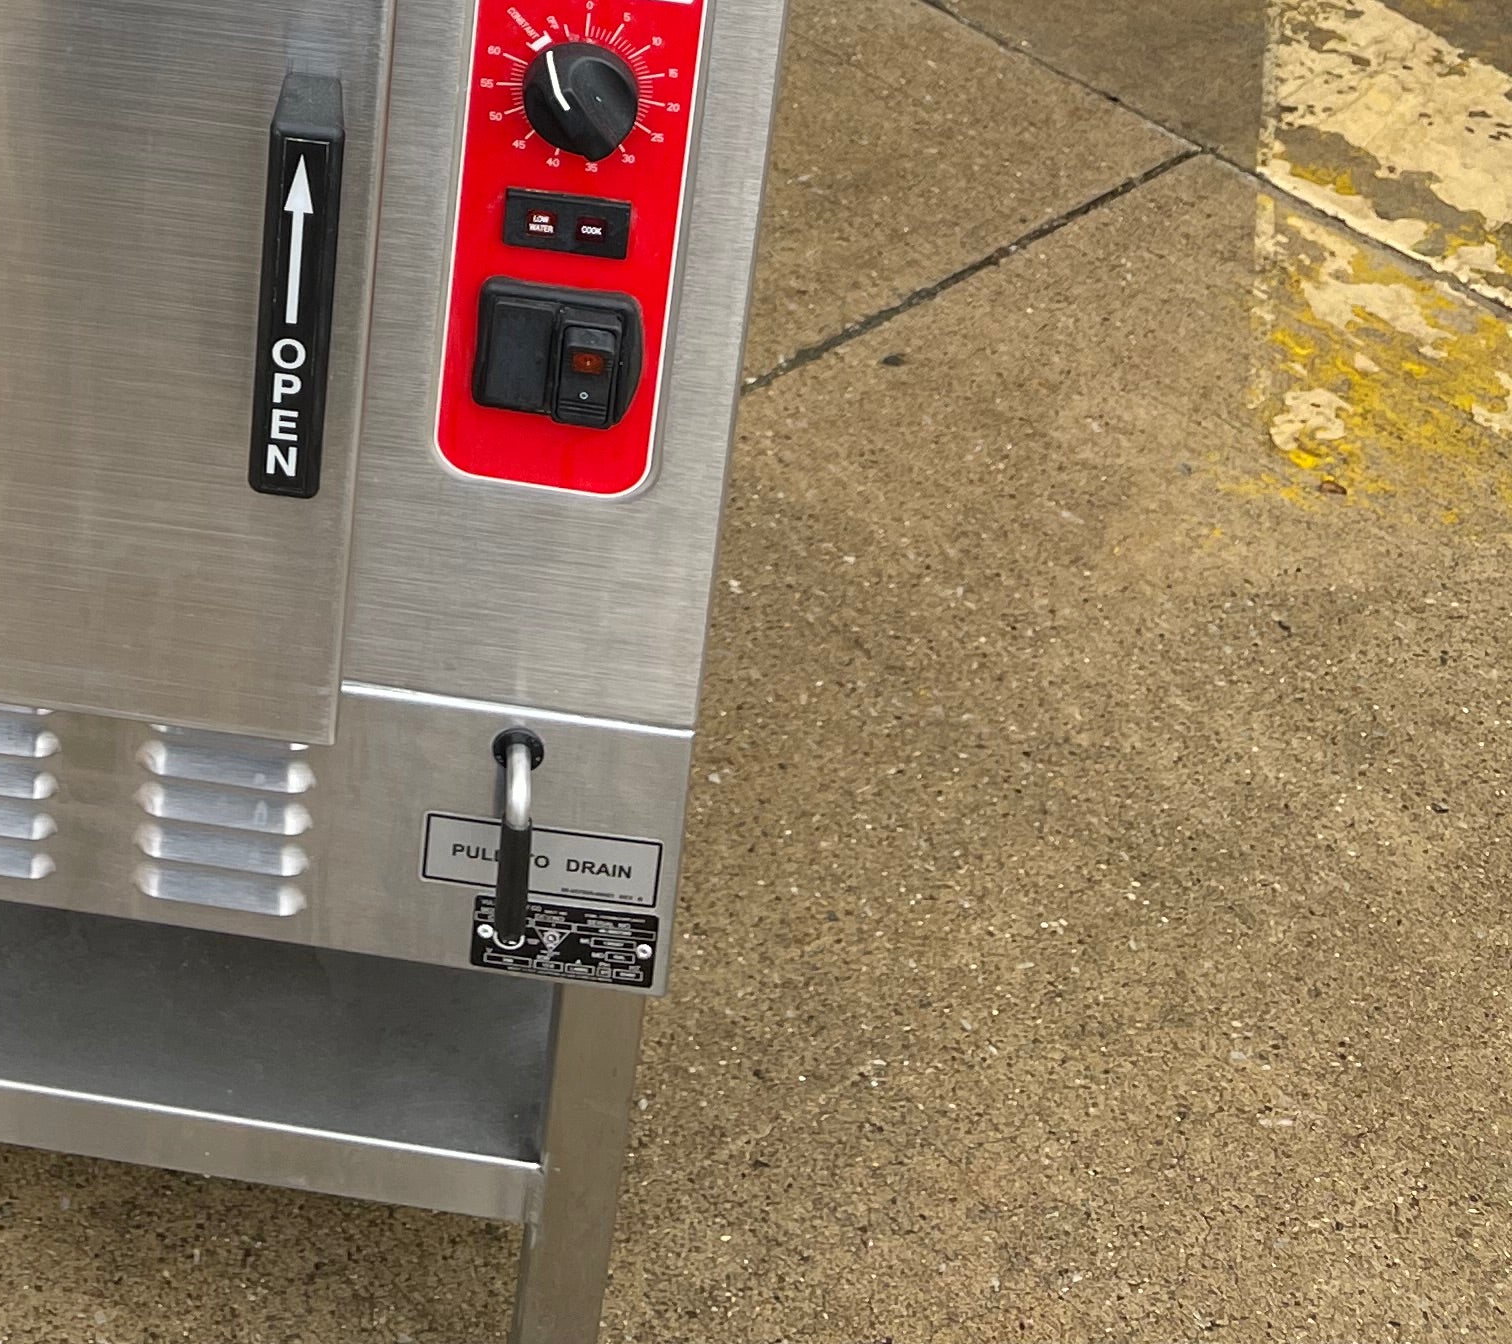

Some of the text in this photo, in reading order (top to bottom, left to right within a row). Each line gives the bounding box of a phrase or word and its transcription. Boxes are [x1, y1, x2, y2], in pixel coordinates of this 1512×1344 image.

[586, 1, 593, 10] 0
[624, 12, 631, 22] 5
[507, 7, 539, 40] CONSTANT
[546, 15, 559, 30] OFF
[652, 36, 662, 47] 10
[488, 46, 501, 55] 60
[668, 69, 679, 78] 15
[480, 79, 494, 88] 55
[667, 103, 680, 112] 20
[489, 112, 503, 121] 50
[650, 133, 664, 143] 25
[512, 140, 526, 149] 45
[546, 158, 560, 167] 40
[621, 154, 635, 163] 30
[585, 162, 598, 172] 35
[533, 214, 549, 223] LOW
[529, 223, 554, 234] WATER
[581, 225, 602, 236] COOK
[265, 338, 307, 477] OPEN
[532, 853, 550, 869] O
[566, 859, 632, 879] DRAIN
